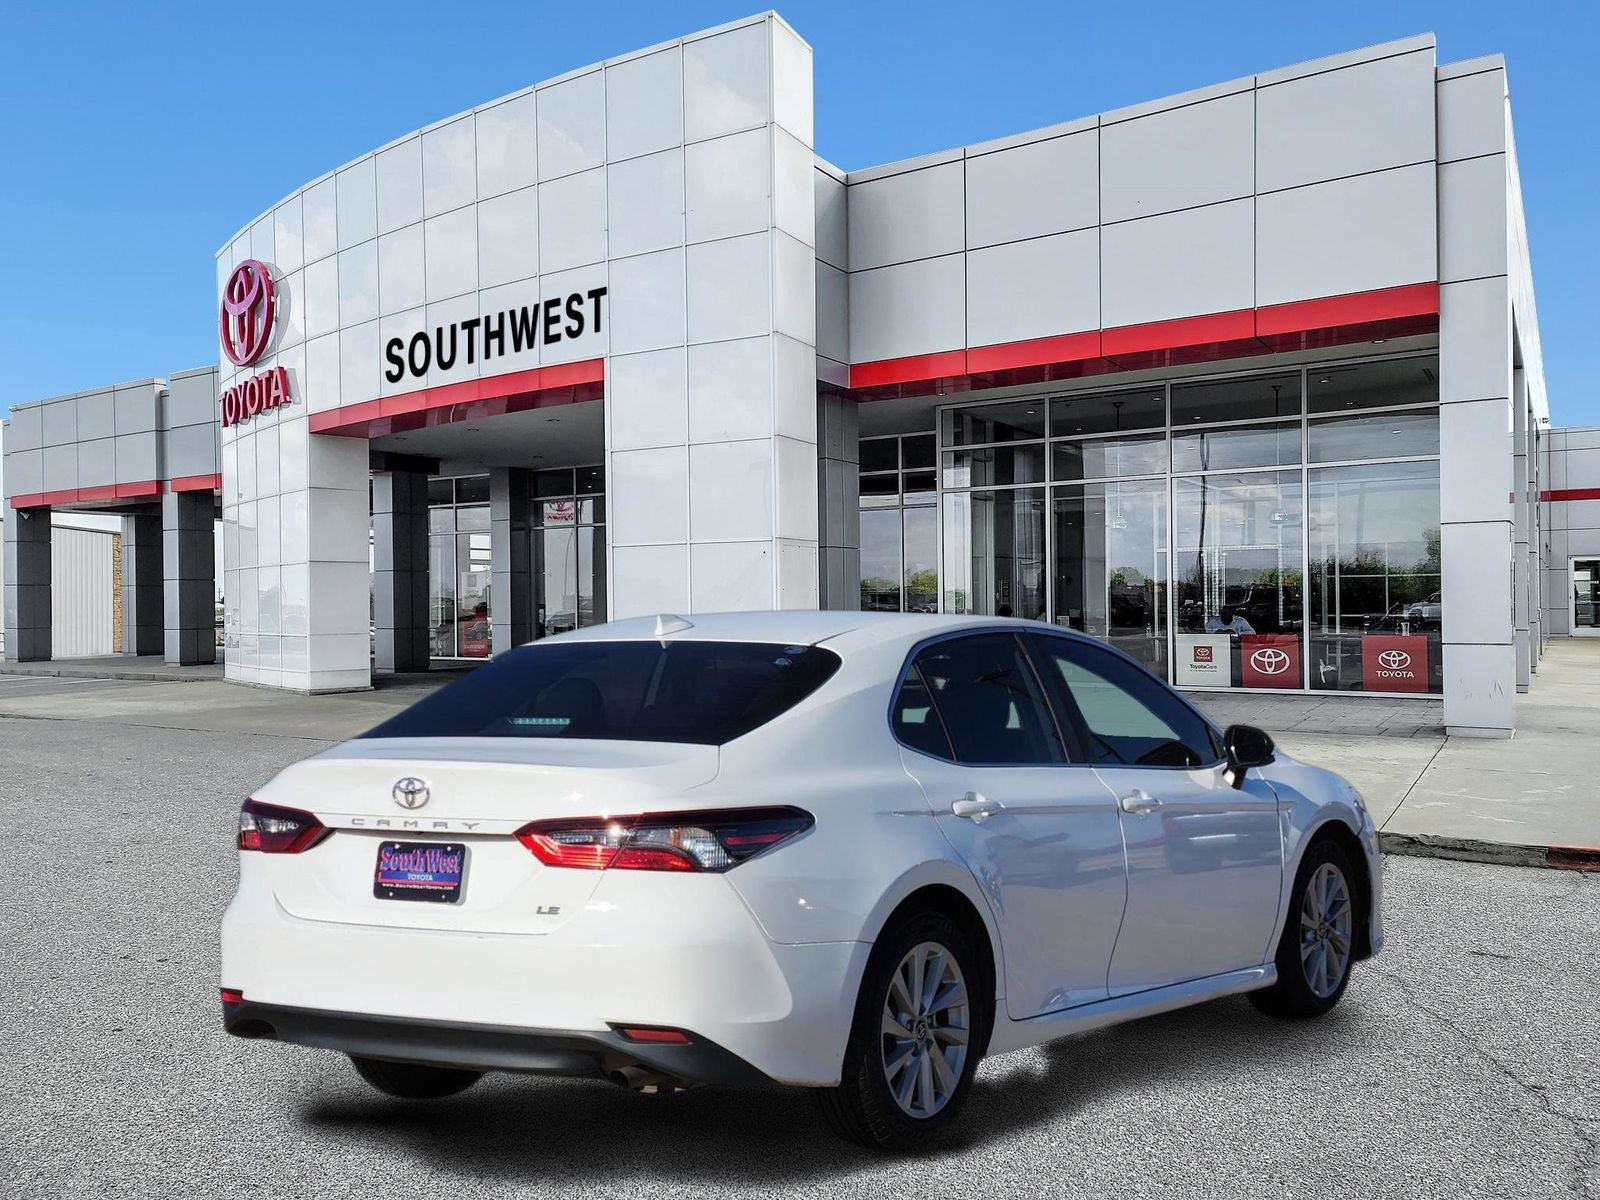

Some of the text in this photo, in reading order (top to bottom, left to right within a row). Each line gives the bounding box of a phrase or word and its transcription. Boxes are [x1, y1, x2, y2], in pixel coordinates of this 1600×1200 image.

[385, 286, 608, 384] SOUTHWEST
[219, 366, 290, 428] TOYOTA
[1375, 670, 1415, 678] TOYOTA
[351, 818, 481, 830] CAMRY
[407, 873, 434, 882] TOYOTA
[535, 906, 561, 915] LE
